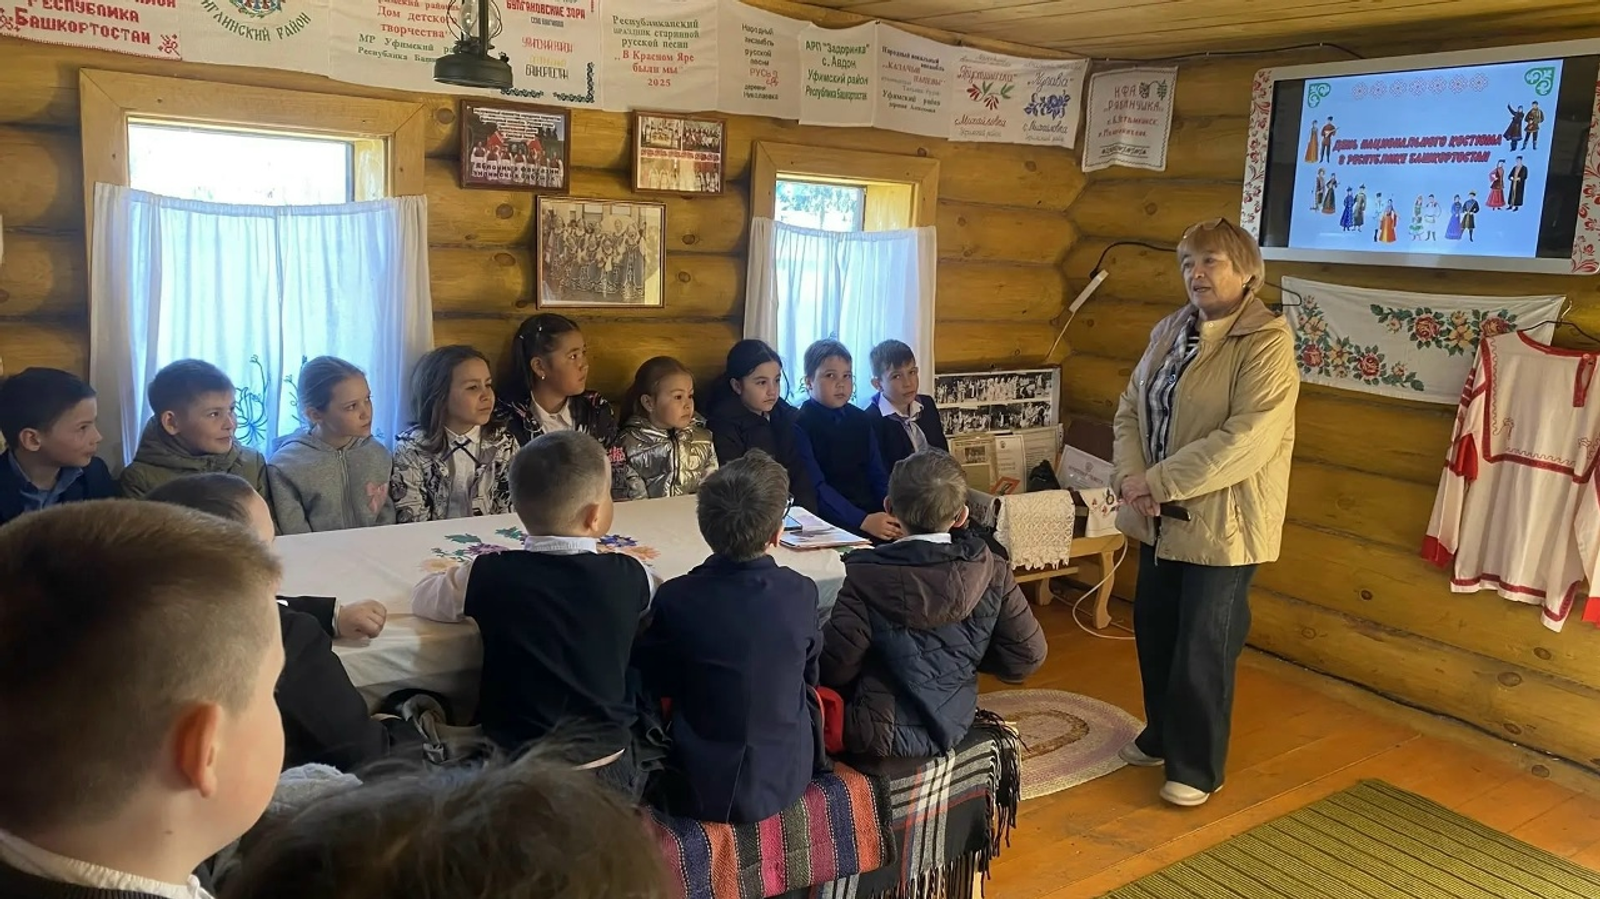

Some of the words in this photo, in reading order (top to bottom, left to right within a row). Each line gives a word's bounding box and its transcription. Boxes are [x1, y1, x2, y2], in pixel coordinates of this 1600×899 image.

[377, 5, 401, 18] Дом
[611, 15, 700, 29] Республиканский
[358, 33, 377, 44] МР
[384, 37, 435, 52] Уфимский
[653, 30, 700, 41] старинной
[621, 38, 659, 49] русской
[662, 41, 689, 49] песни
[805, 40, 822, 52] АРП
[357, 46, 409, 60] Республика
[632, 50, 674, 62] Красном
[677, 52, 695, 64] Яре
[632, 62, 660, 74] были
[647, 78, 671, 87] 2025
[807, 68, 846, 84] Уфимский
[847, 74, 869, 86] район
[881, 89, 917, 103] Уфимский
[1332, 139, 1359, 152] ДЕНЬ
[1360, 136, 1448, 151] НАЦИОНАЛЬНОГО
[1448, 134, 1502, 148] КОСТЮМА
[1338, 154, 1346, 165] В
[1408, 151, 1491, 164] БАШКОРТОСТАН
